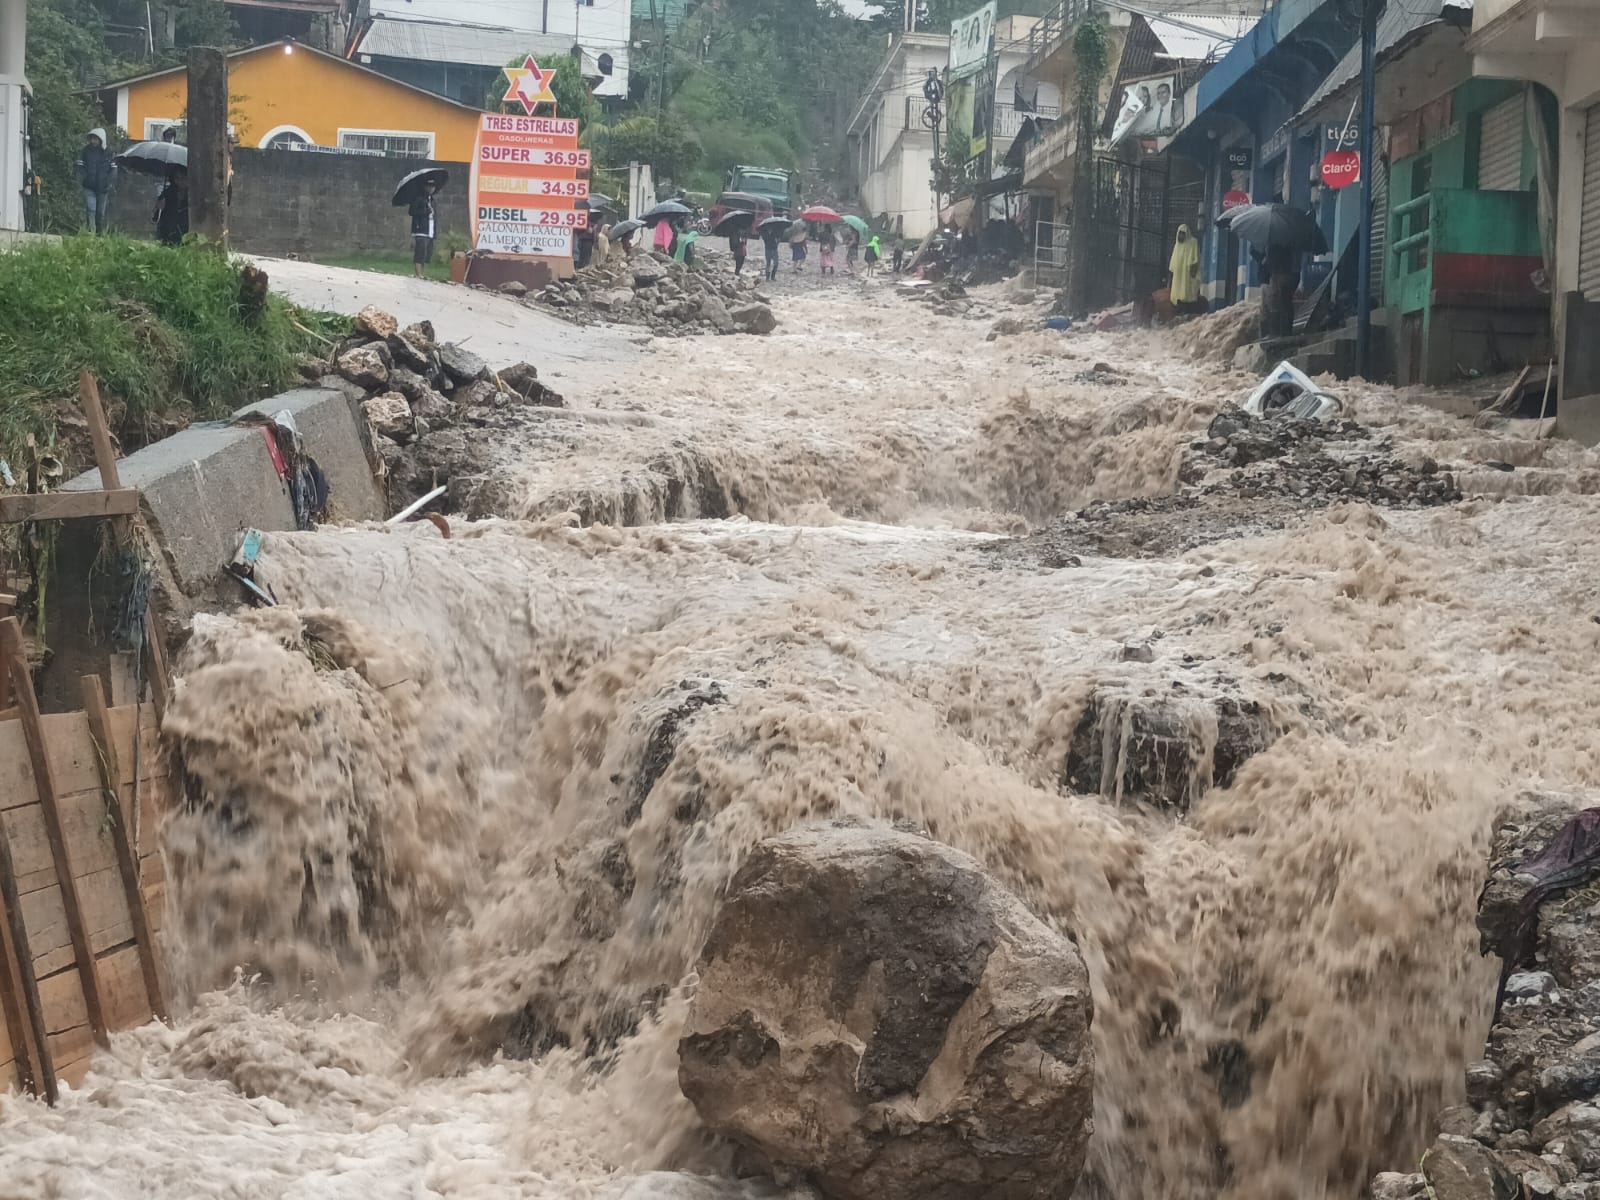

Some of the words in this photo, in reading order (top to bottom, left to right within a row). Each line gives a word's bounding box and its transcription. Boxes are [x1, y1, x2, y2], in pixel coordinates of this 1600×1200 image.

[486, 117, 513, 130] TRES
[516, 119, 575, 134] ESTRELLAS
[499, 135, 553, 144] GASOLINERAS
[481, 147, 530, 162] SUPER
[544, 151, 588, 166] 36.95
[1322, 163, 1352, 174] Claro
[480, 176, 528, 192] REGULAR
[541, 181, 586, 196] 34.95
[479, 207, 527, 222] DIESEL
[539, 211, 586, 226] 29.95
[478, 223, 529, 234] GALONAJE
[532, 225, 571, 237] EXACTO
[481, 234, 494, 244] AL
[496, 235, 528, 246] MEJOR
[530, 237, 565, 248] PRECIO
